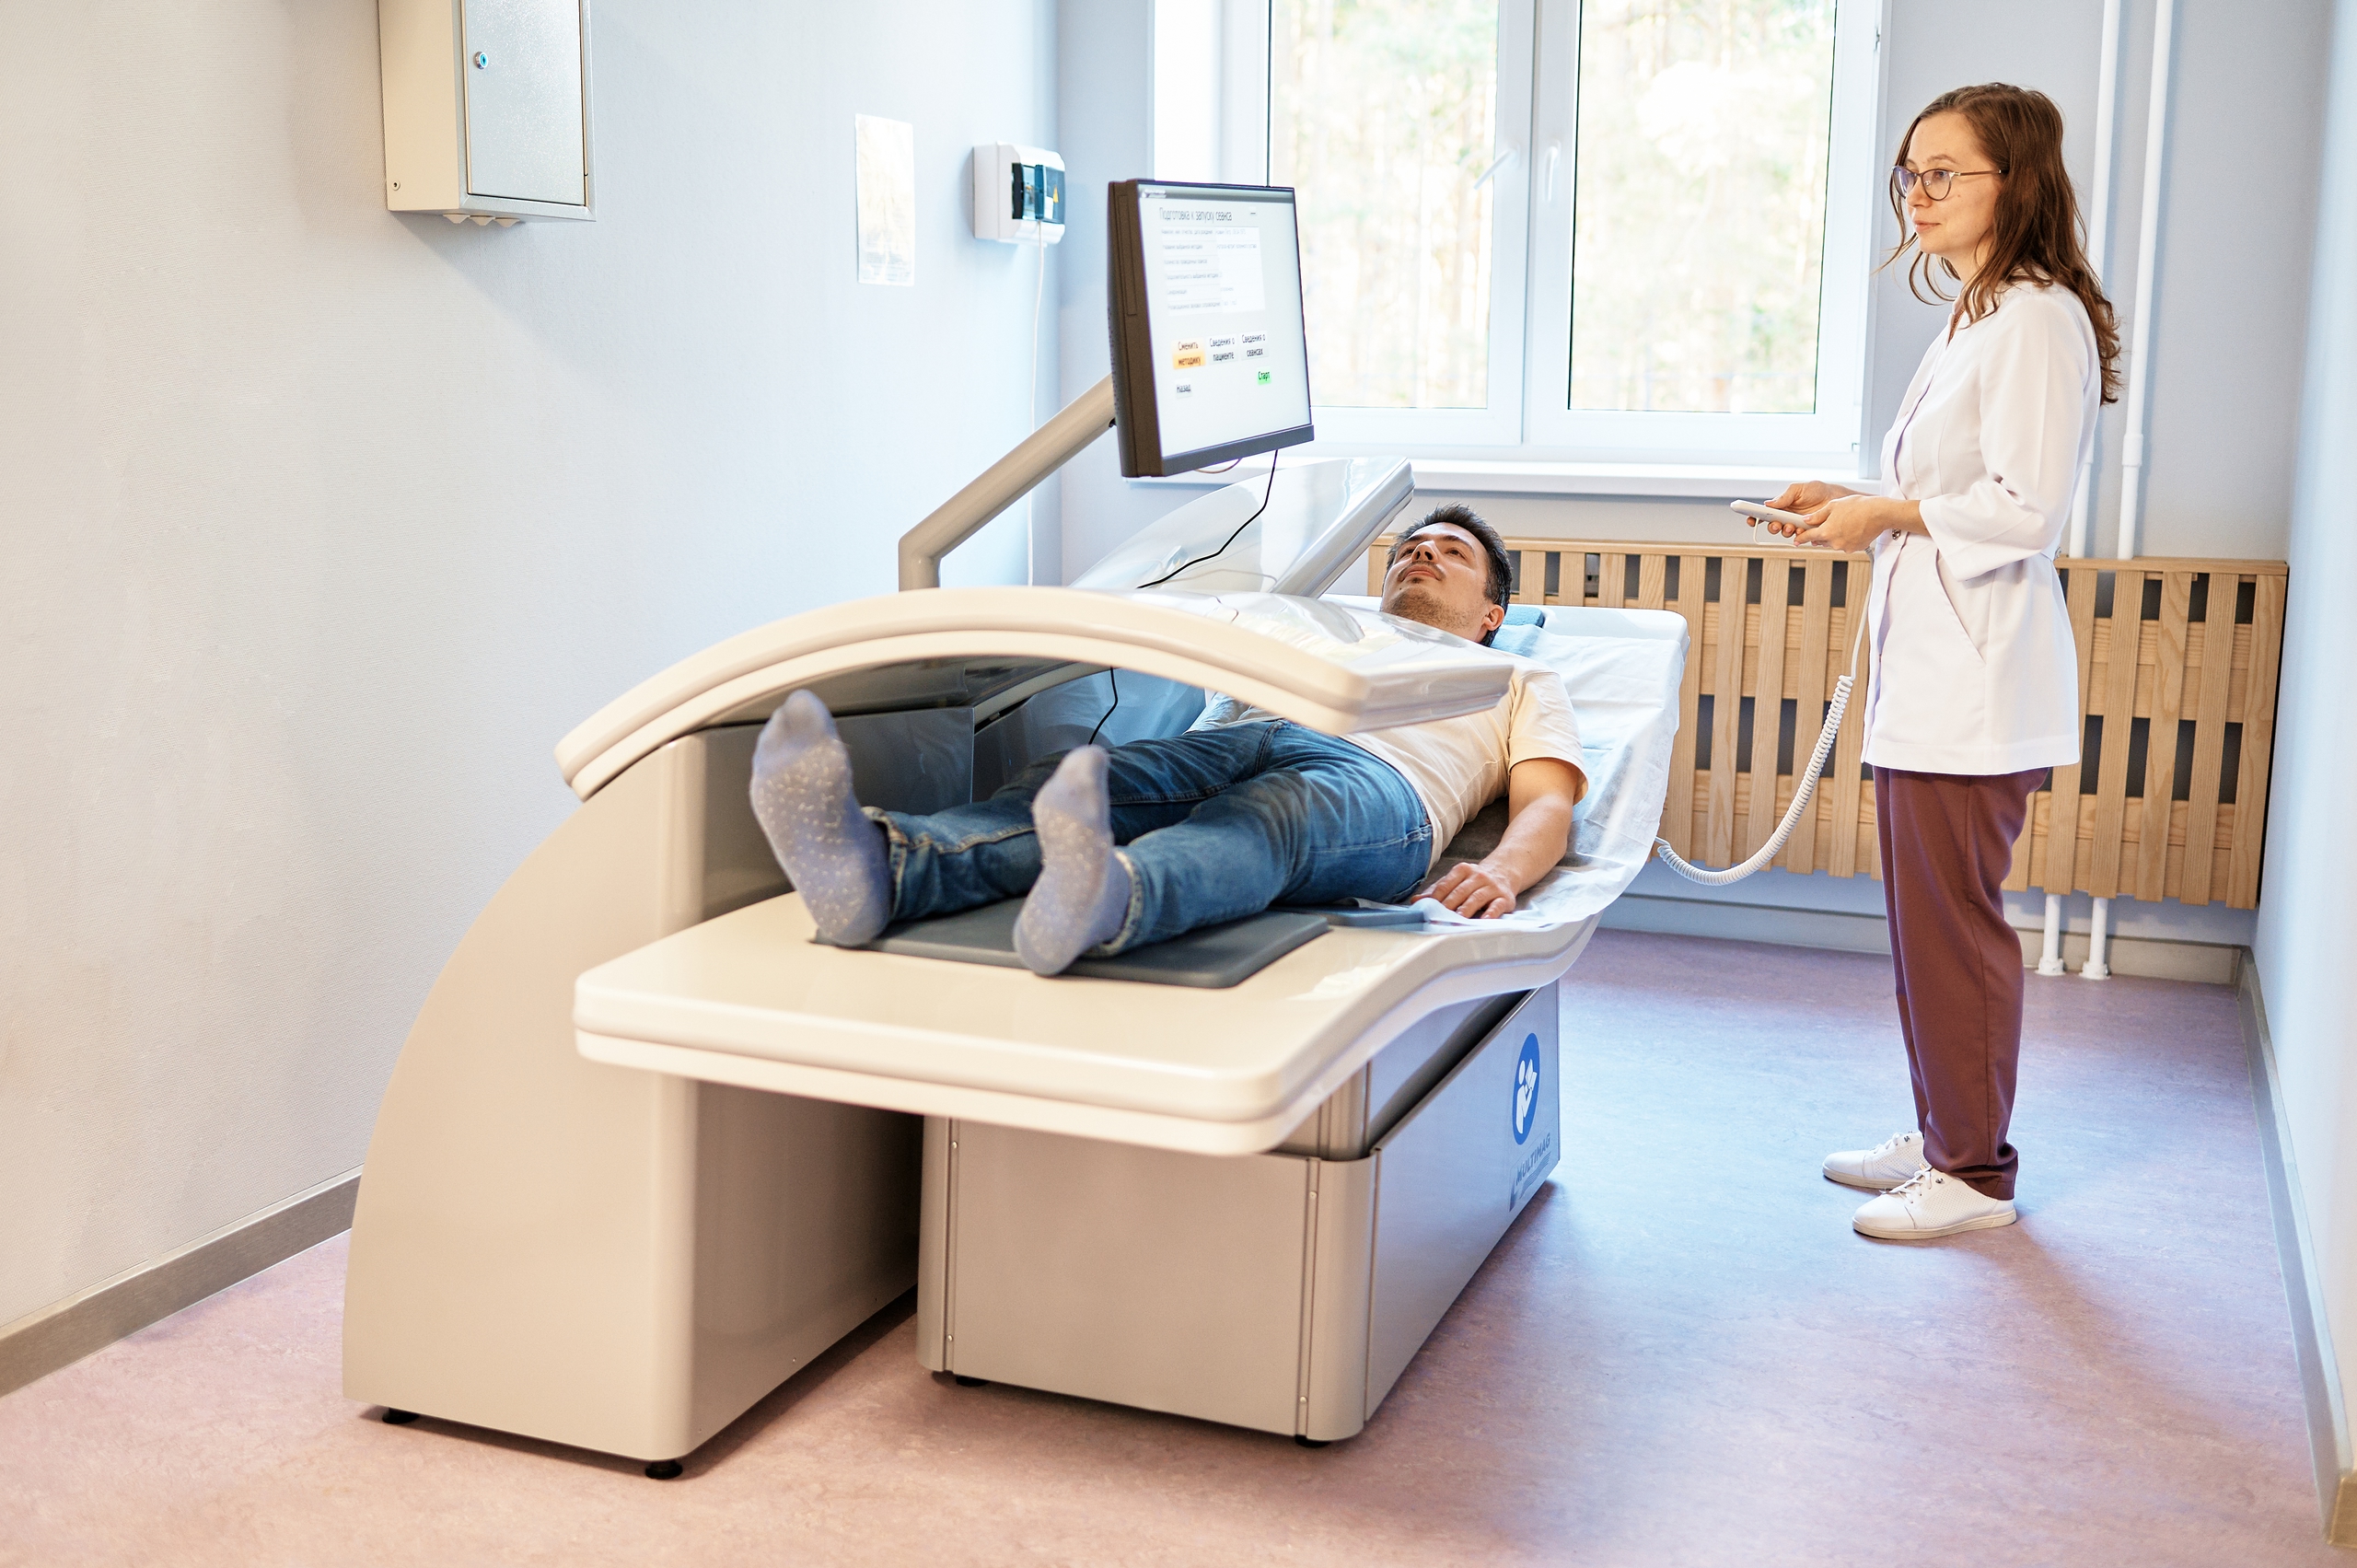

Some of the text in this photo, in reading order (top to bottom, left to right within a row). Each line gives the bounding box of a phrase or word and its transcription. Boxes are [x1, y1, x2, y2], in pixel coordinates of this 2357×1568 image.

[1159, 207, 1190, 221] Подготовка
[1196, 211, 1214, 224] запуску
[1215, 211, 1232, 221] сеанса
[1209, 337, 1231, 348] Сведения
[1241, 334, 1262, 343] Сведения
[1178, 342, 1199, 351] Сменить
[1247, 347, 1263, 357] сеансах
[1178, 355, 1202, 366] методику
[1213, 351, 1235, 362] пациенте
[1258, 370, 1271, 381] Старт
[1176, 383, 1191, 394] Назад
[1515, 1132, 1550, 1186] MULTIMAG
